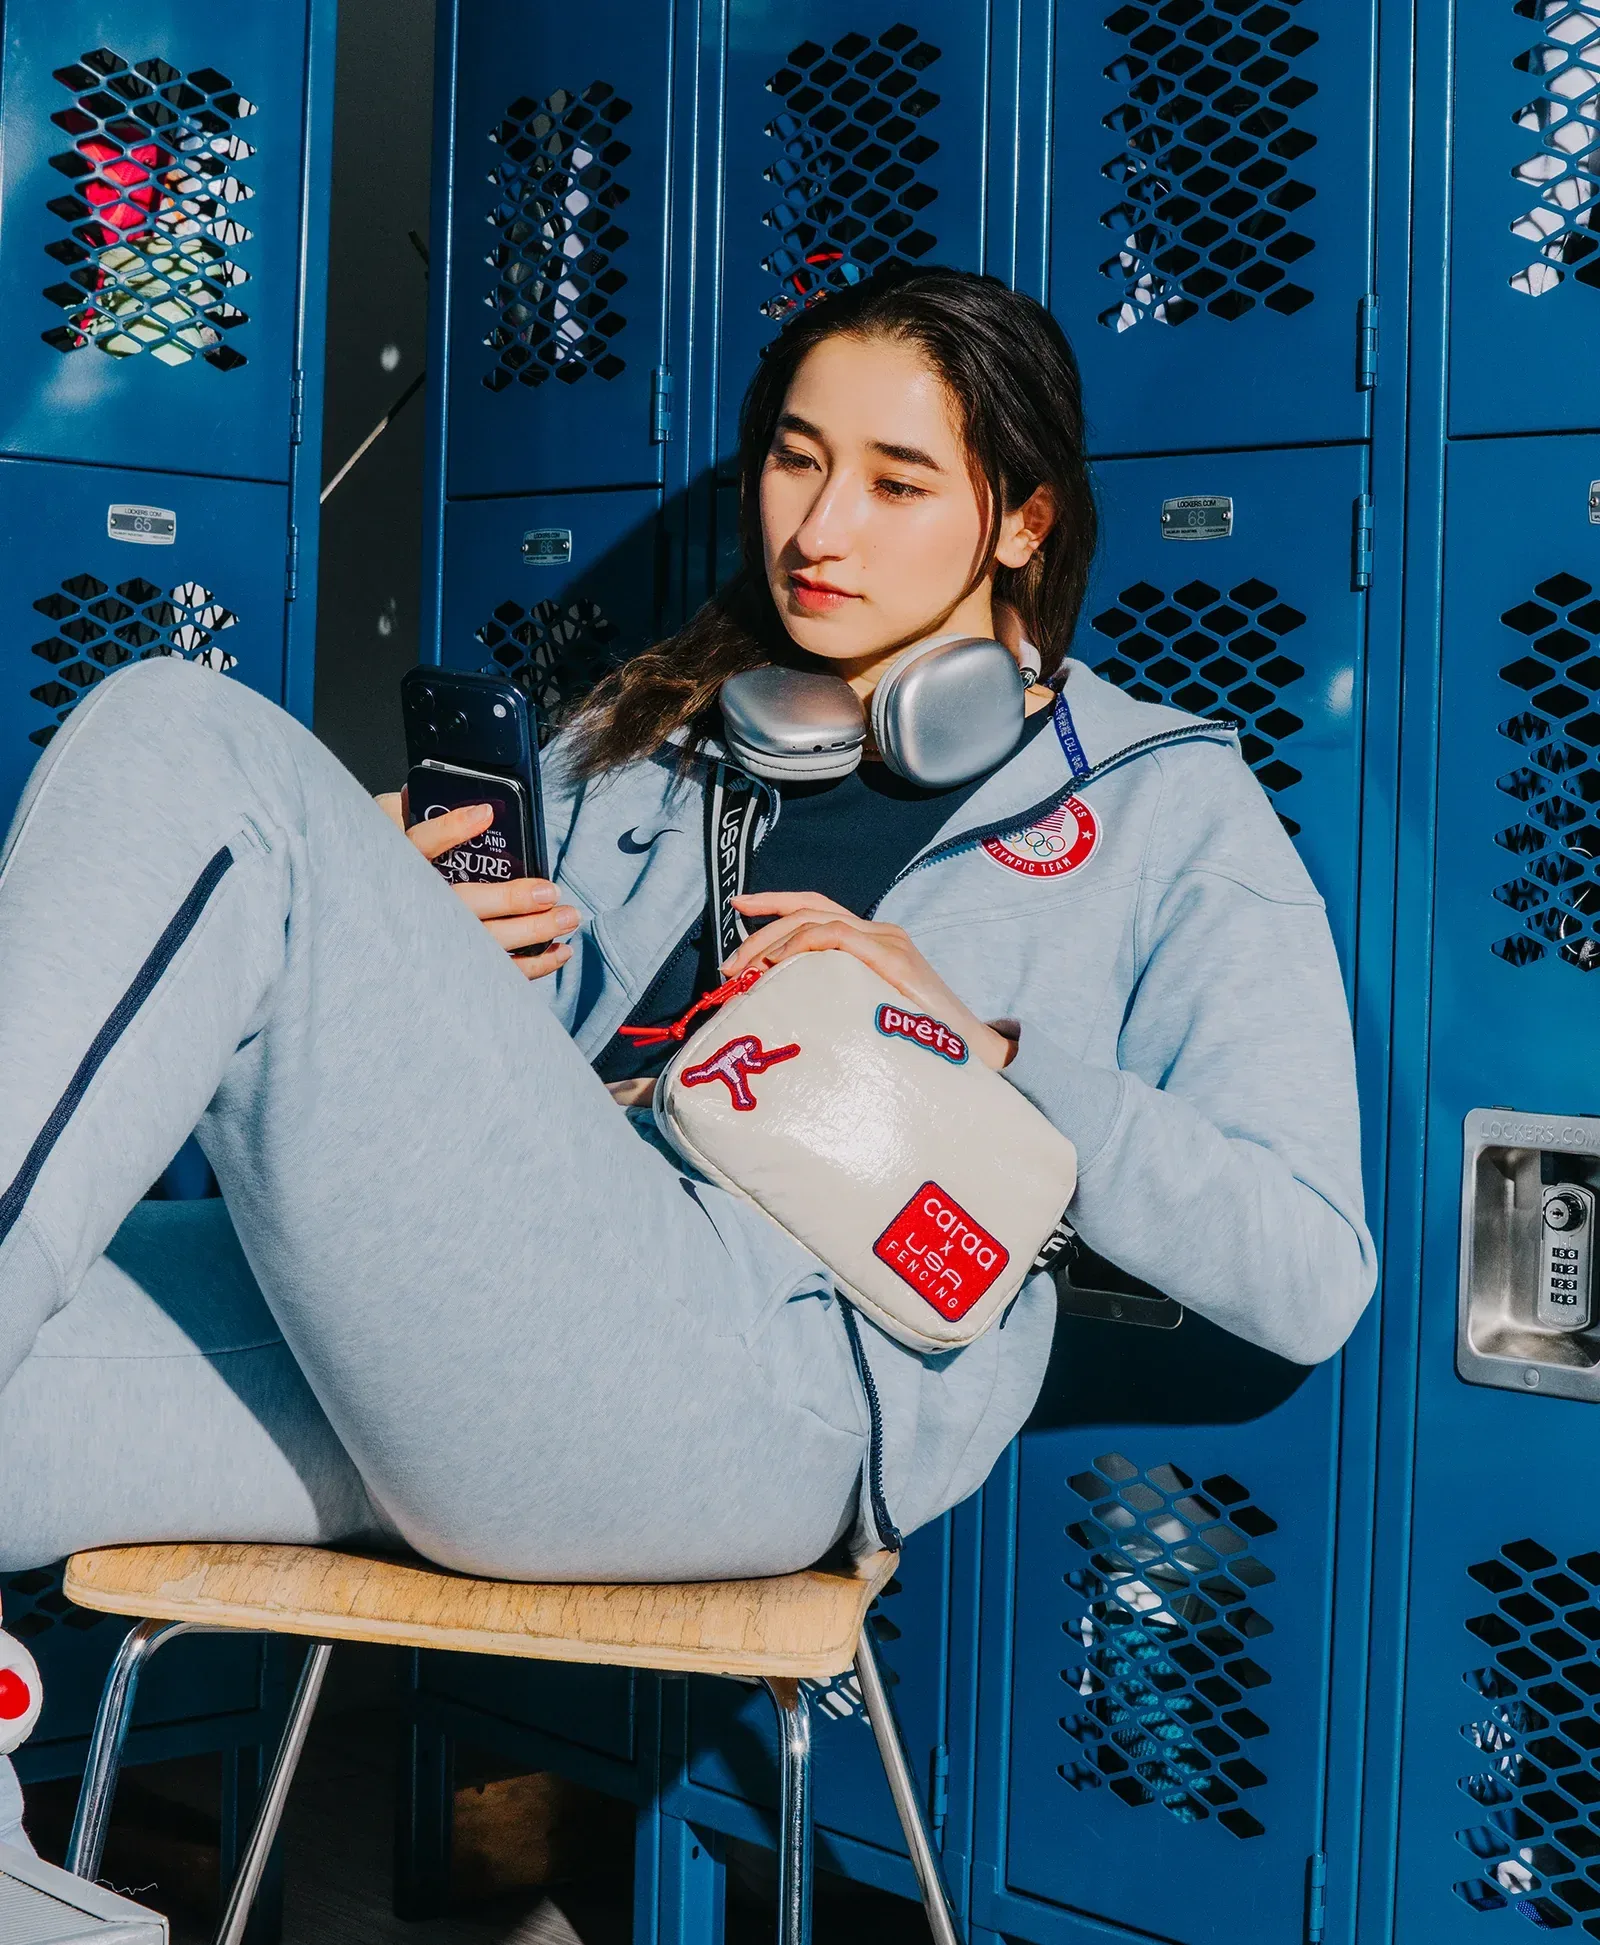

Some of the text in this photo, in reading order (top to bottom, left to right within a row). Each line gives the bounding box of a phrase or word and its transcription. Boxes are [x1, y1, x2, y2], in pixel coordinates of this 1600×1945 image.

[1177, 500, 1216, 508] LOCKERS.COM
[1188, 510, 1206, 526] 68
[135, 518, 152, 532] 65
[541, 541, 553, 553] 66
[1063, 798, 1088, 819] ATES
[485, 835, 506, 848] AND
[434, 850, 511, 879] EISURE
[987, 842, 1072, 874] OLYMPIC TEAM
[720, 807, 742, 947] USA FENC
[884, 1008, 962, 1056] prêts
[923, 1198, 999, 1271] caraa
[885, 1240, 959, 1309] FENCING
[904, 1232, 963, 1291] USA
